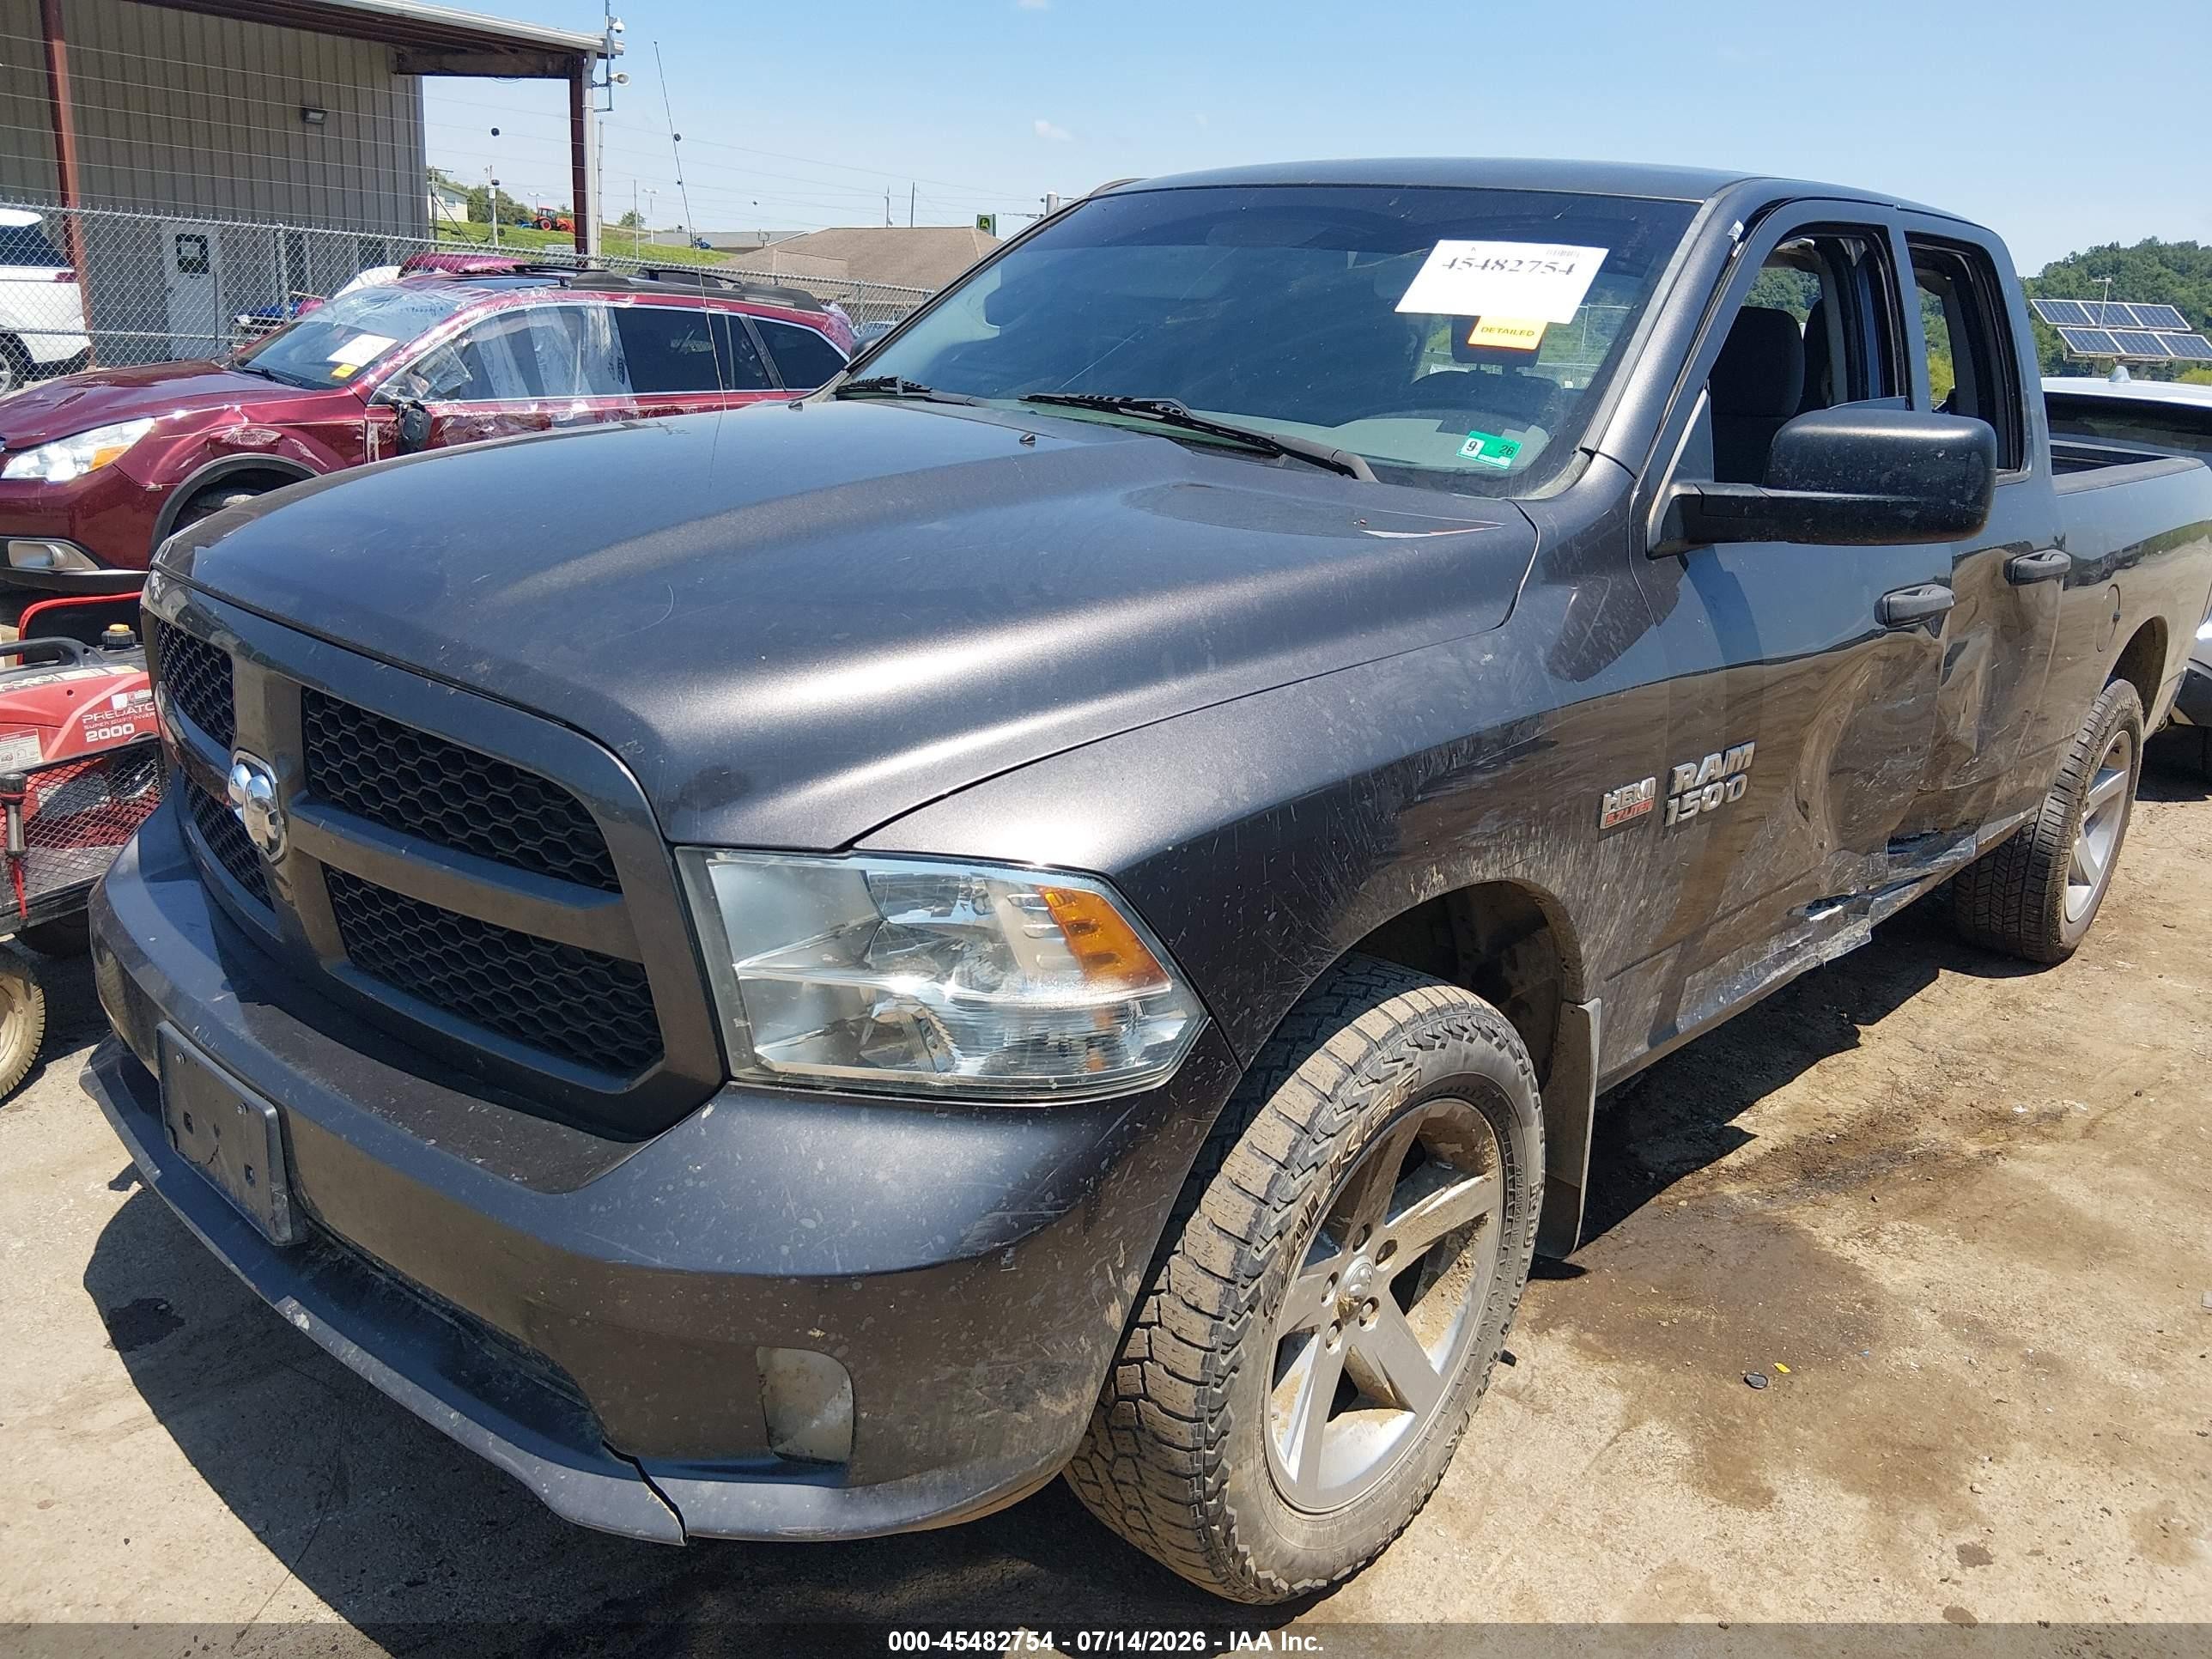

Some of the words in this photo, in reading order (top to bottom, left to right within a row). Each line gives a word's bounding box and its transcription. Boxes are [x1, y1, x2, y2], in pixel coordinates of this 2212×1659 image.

[1443, 257, 1576, 276] 45482754
[1480, 326, 1535, 337] DETAILED
[1467, 441, 1478, 452] 9
[1498, 445, 1516, 456] 26
[85, 723, 135, 743] 2000
[1669, 741, 1755, 795] RAM
[1601, 776, 1656, 813] HEMI
[1664, 773, 1748, 827] 1500
